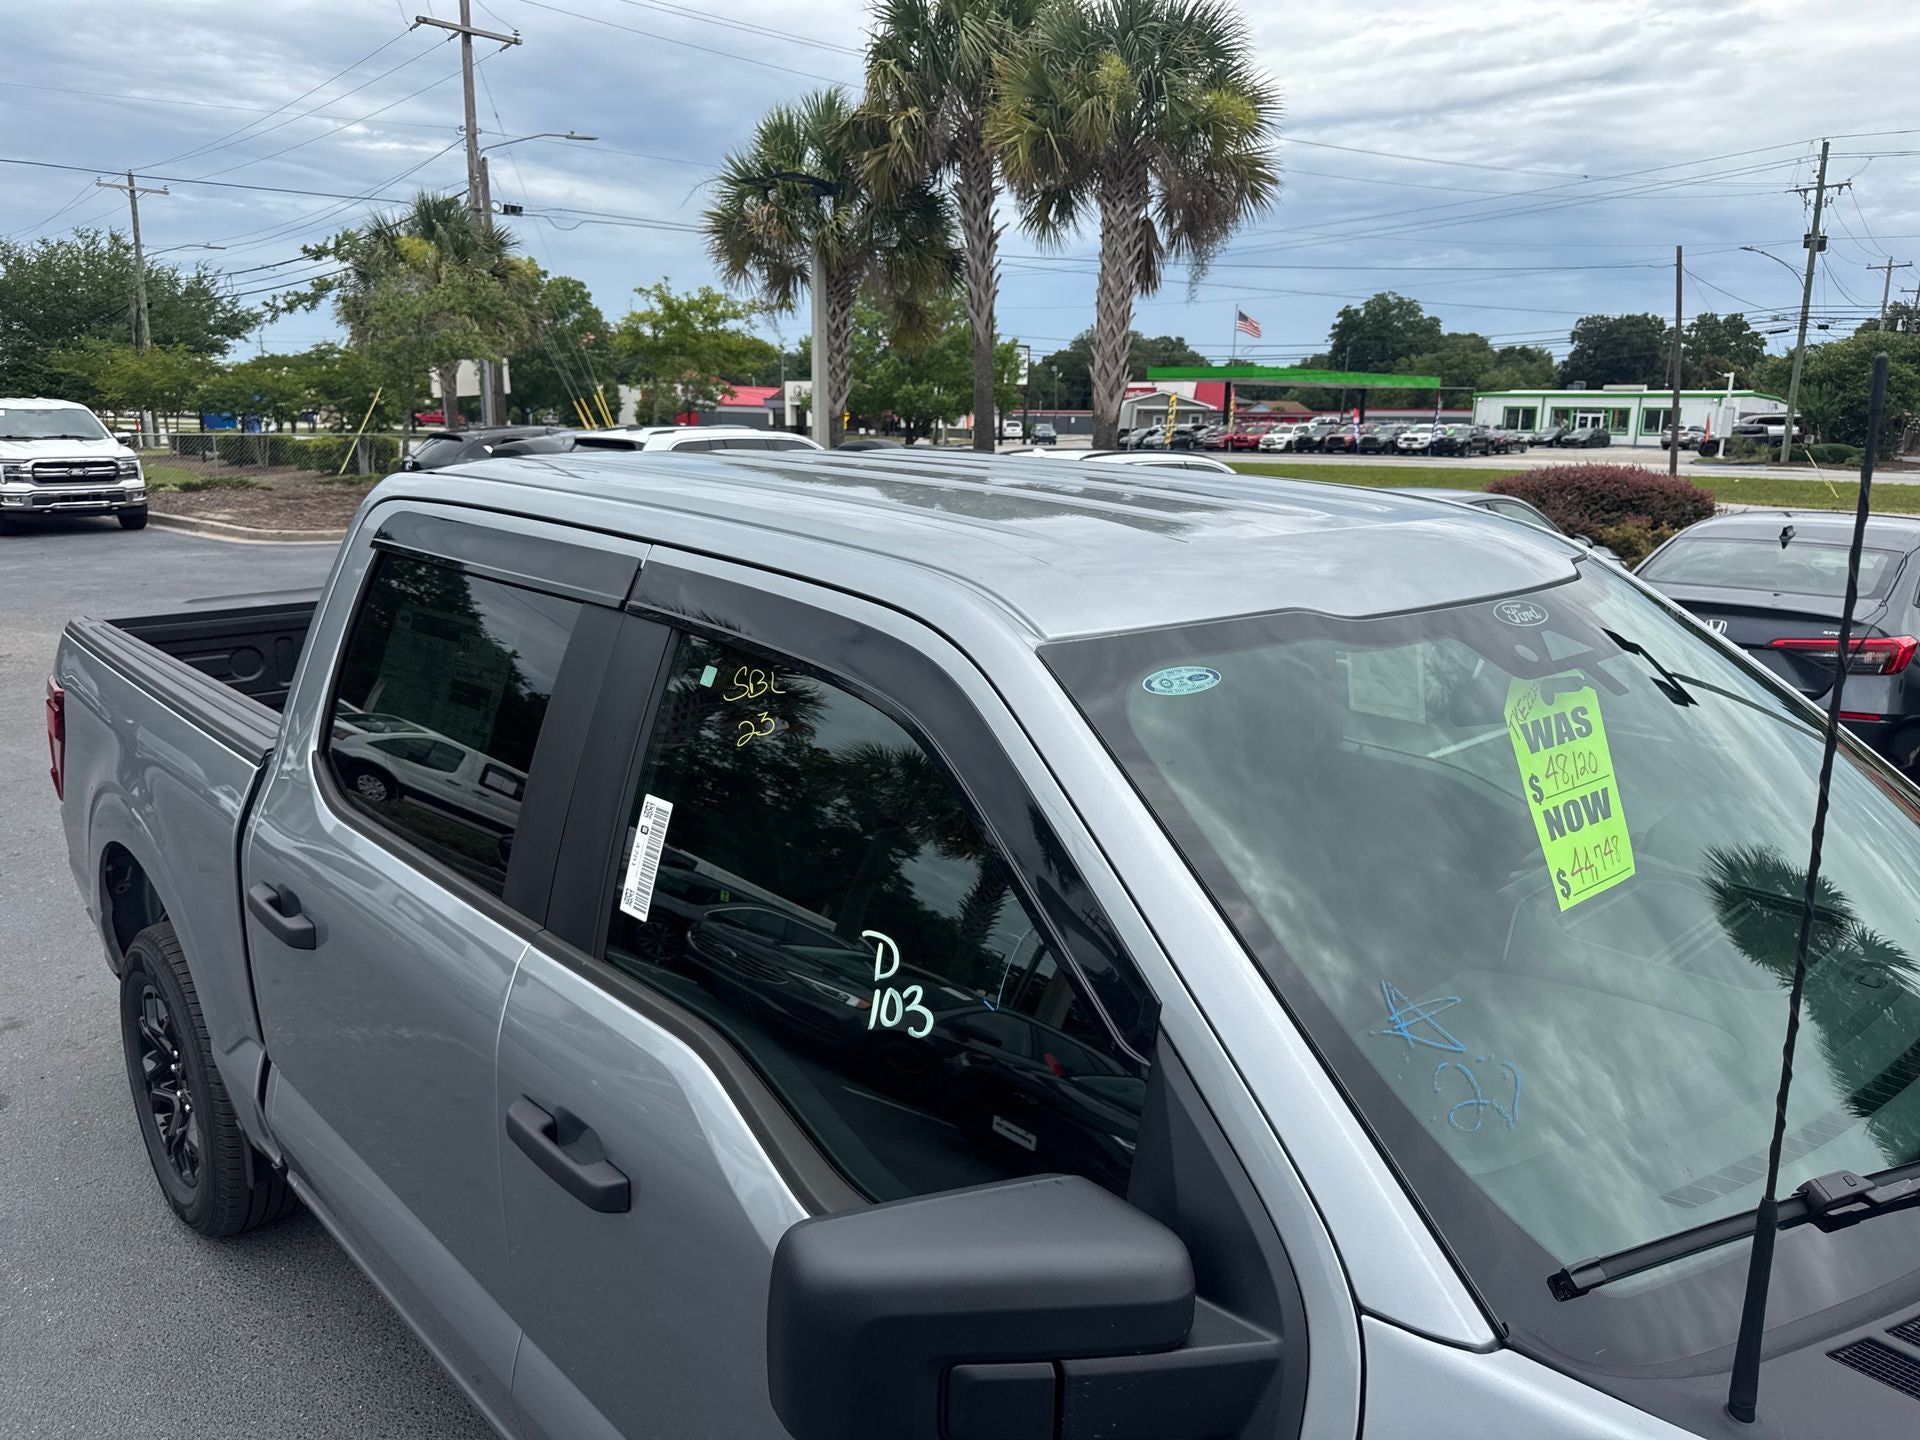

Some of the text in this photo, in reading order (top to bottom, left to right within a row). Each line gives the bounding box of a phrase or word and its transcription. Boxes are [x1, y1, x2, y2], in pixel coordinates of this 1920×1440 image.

[1501, 603, 1542, 623] Ford
[723, 666, 786, 702] SBL
[736, 711, 775, 747] 23
[1520, 706, 1593, 754] WAS
[1528, 751, 1598, 805] $ 48,120
[1542, 787, 1612, 842] NOW
[1556, 867, 1572, 900] $
[861, 929, 900, 982] D
[867, 984, 935, 1039] 103
